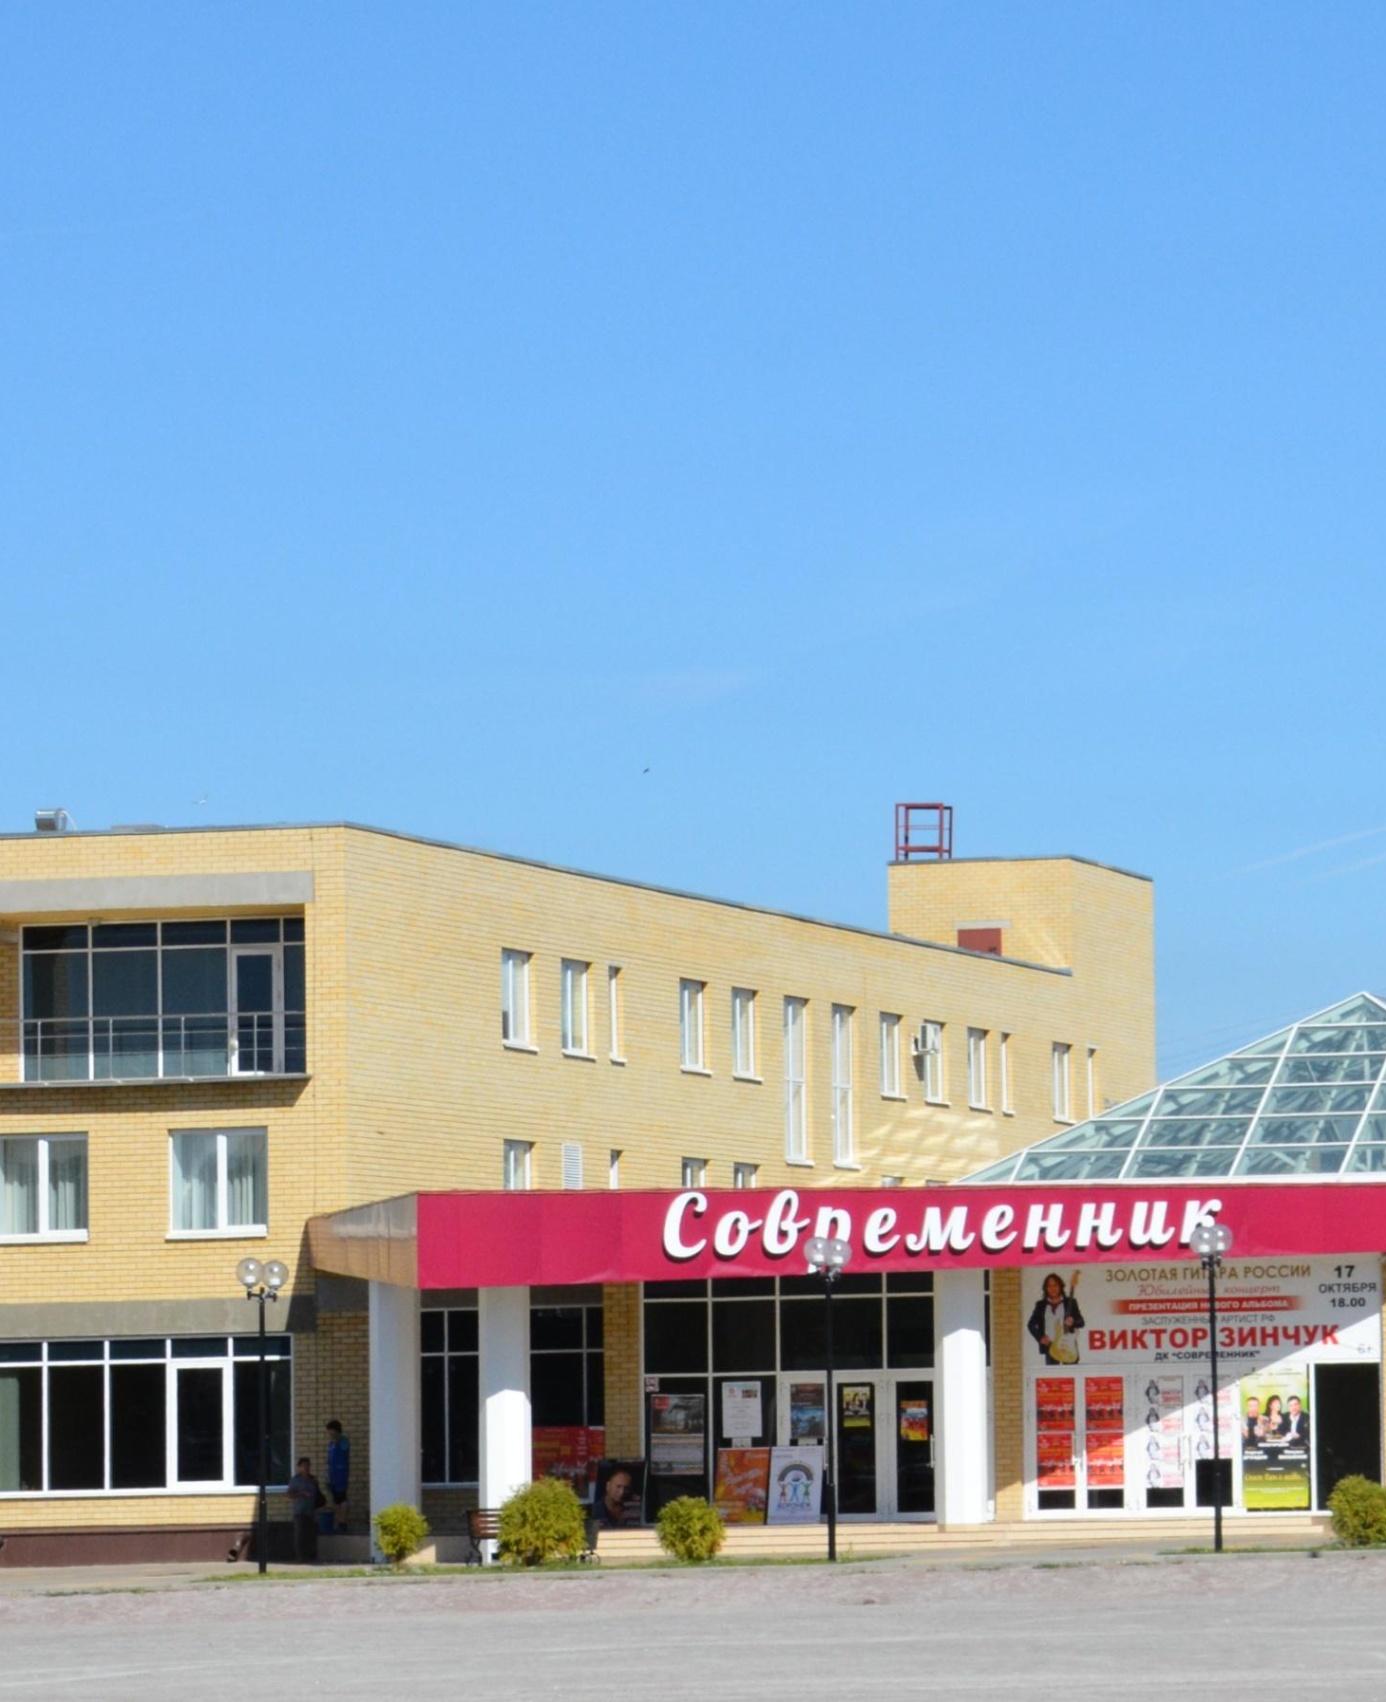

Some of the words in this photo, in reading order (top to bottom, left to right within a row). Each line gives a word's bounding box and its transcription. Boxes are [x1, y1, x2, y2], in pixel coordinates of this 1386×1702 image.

[663, 1190, 1222, 1273] Современник
[1106, 1268, 1178, 1282] ЗОЛОТАЯ
[1183, 1266, 1239, 1280] ГИТРА
[1243, 1265, 1312, 1280] РОССИИ
[1334, 1265, 1355, 1279] 17
[1137, 1284, 1214, 1296] Юбилейны
[1318, 1282, 1377, 1294] ОКТЯБРЯ
[1128, 1301, 1198, 1311] ПРЕЗЕНТАЦИЯ
[1200, 1300, 1240, 1310] НВОГО
[1241, 1299, 1289, 1309] АЛЬБОМА
[1330, 1297, 1366, 1308] 18.00
[1141, 1315, 1218, 1325] ЗАСЛУЖЕННЫ
[1220, 1314, 1258, 1324] АРТИСТ
[1261, 1313, 1276, 1322] РФ
[1088, 1327, 1208, 1351] ВИКТОР
[1219, 1324, 1339, 1348] ЗИНЧУК
[1154, 1351, 1169, 1362] ДК
[1172, 1350, 1260, 1360] "СОВРЕЕННИК"
